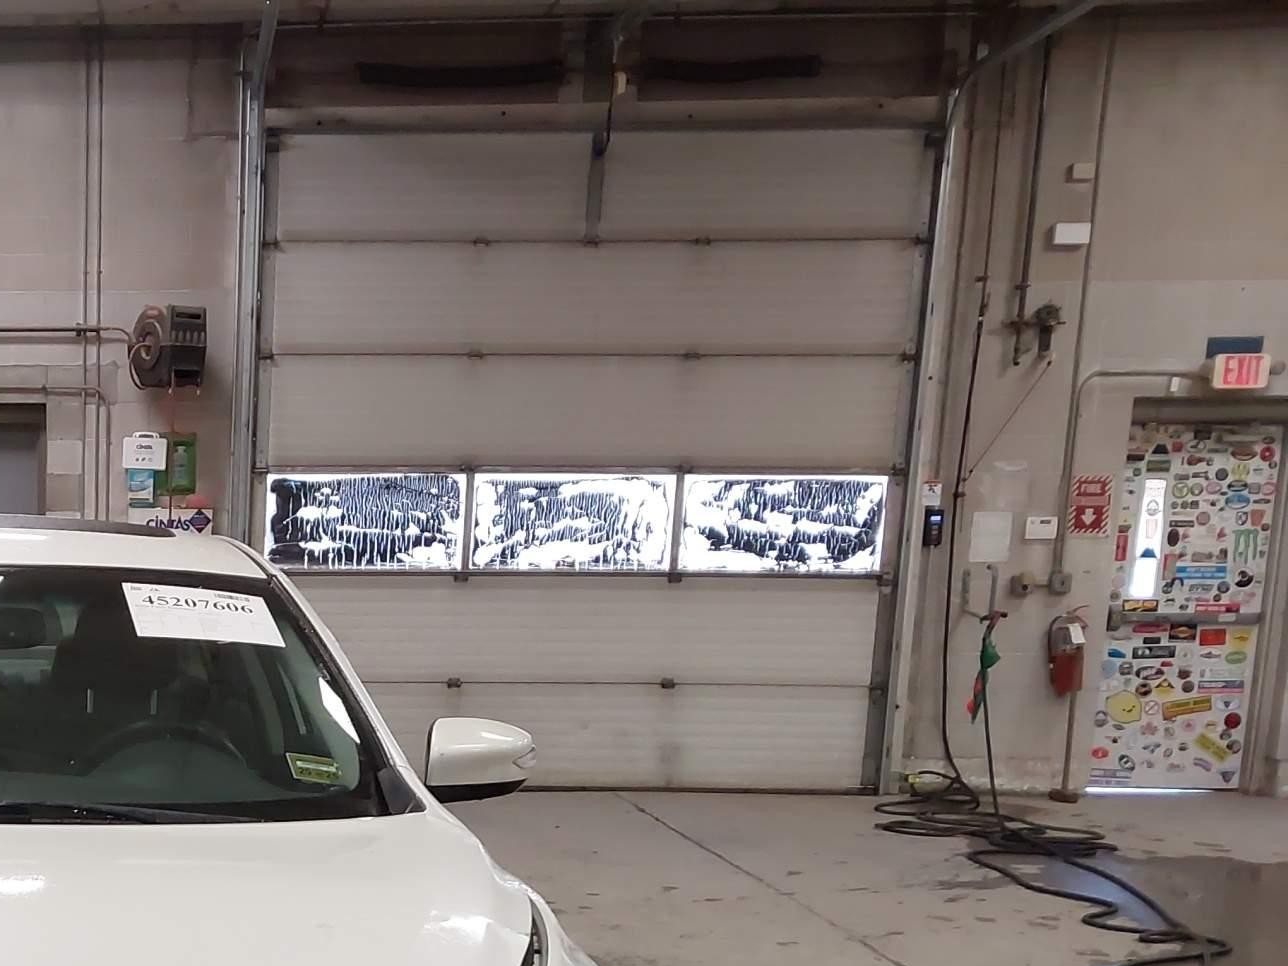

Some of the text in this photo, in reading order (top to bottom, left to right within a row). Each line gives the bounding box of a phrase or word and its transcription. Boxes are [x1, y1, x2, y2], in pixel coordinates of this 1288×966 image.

[1223, 355, 1265, 385] EXIT
[146, 515, 191, 531] CINTAS
[142, 594, 254, 615] 45207606
